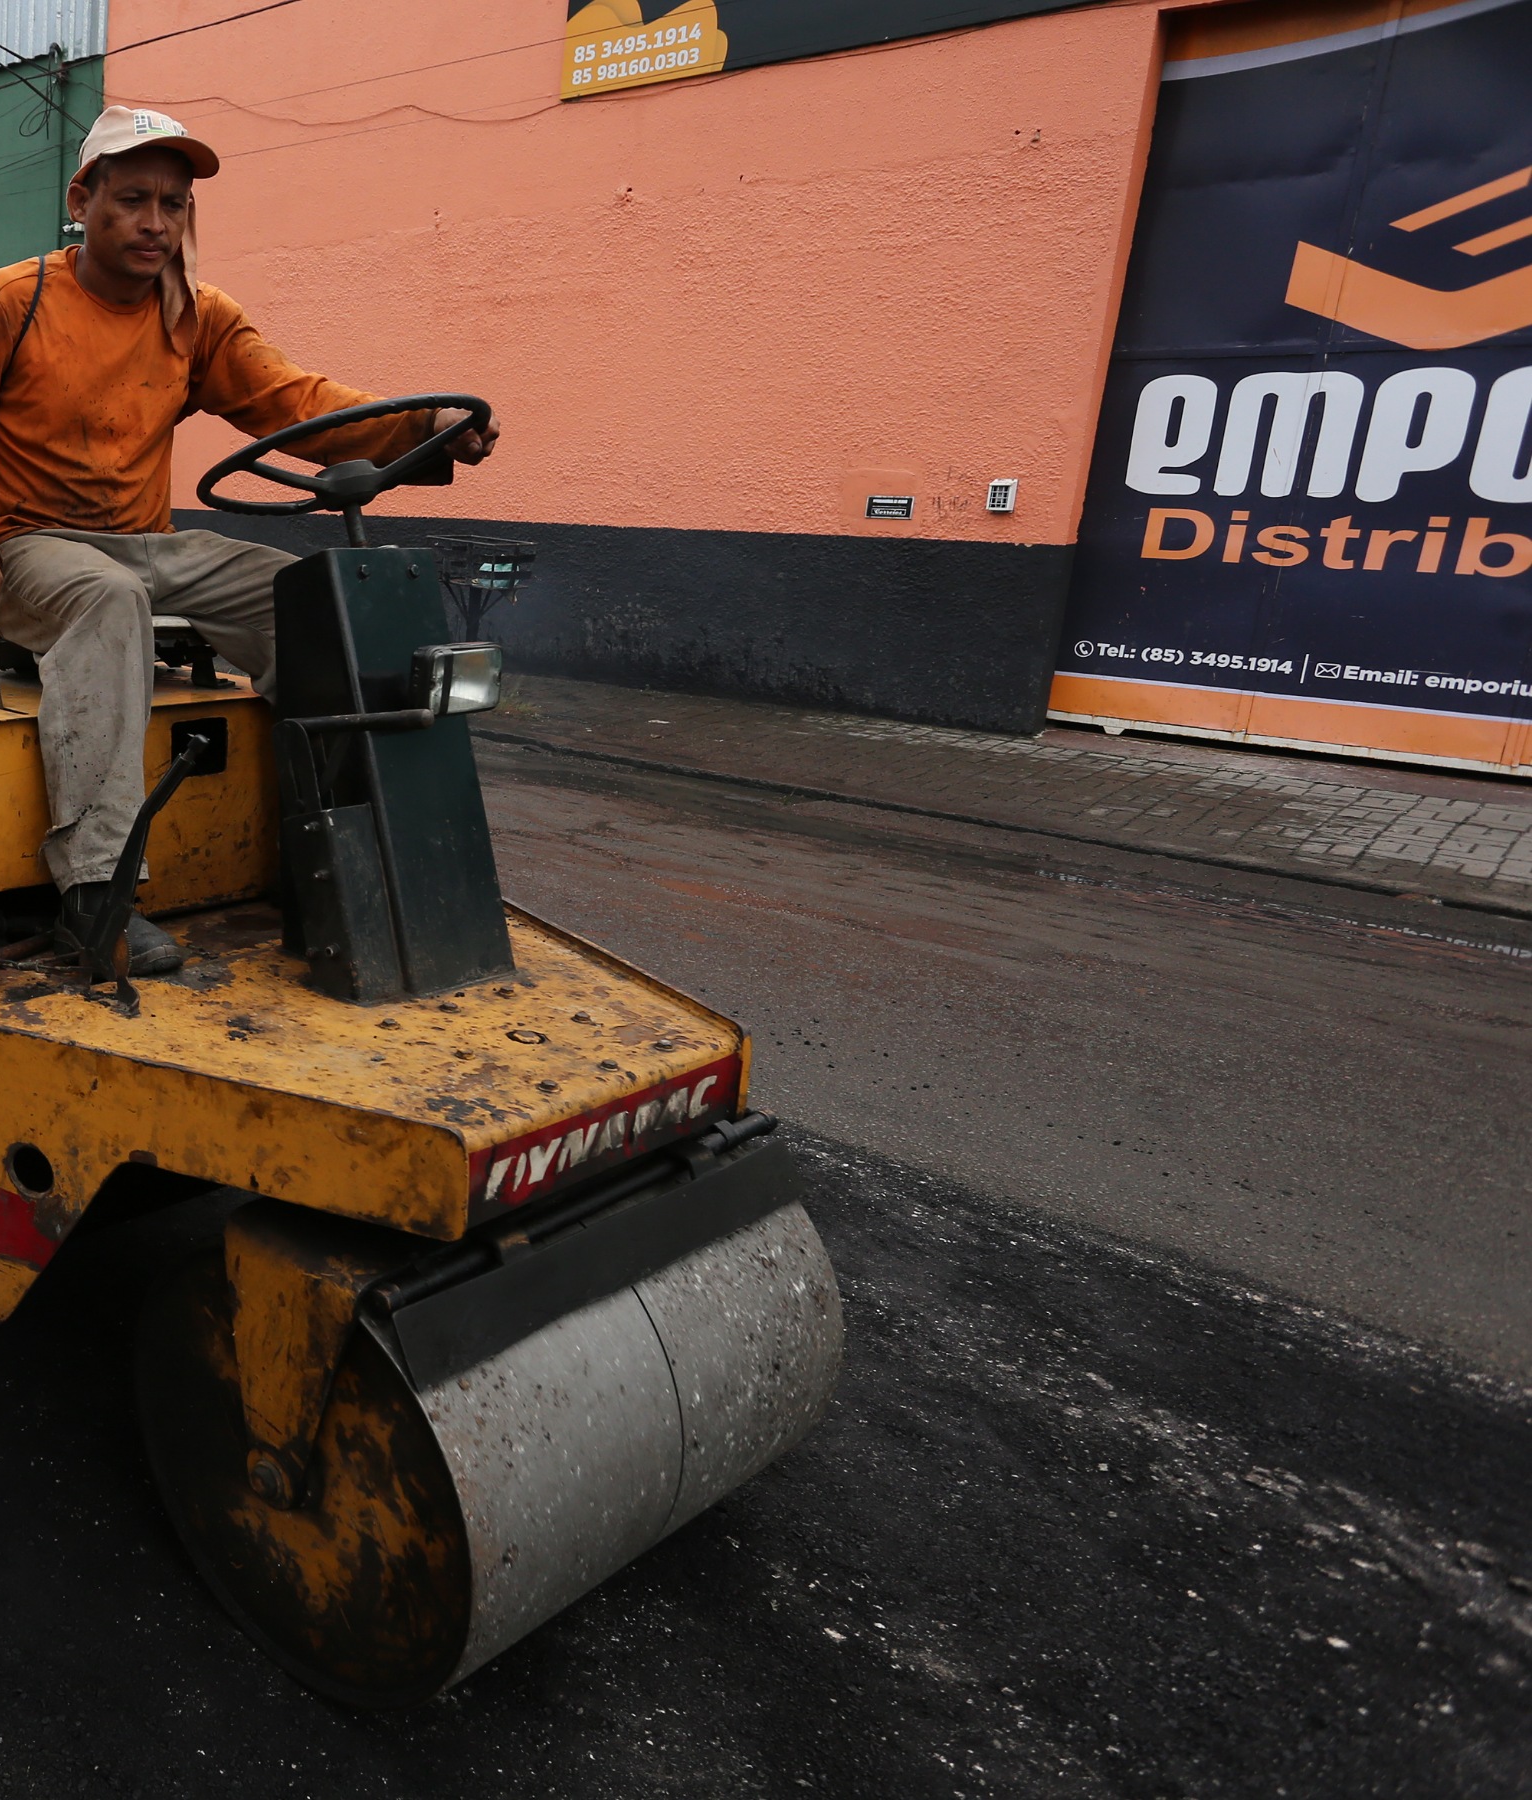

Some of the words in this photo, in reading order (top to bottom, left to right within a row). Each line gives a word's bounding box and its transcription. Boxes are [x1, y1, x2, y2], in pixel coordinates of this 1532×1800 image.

[571, 67, 593, 85] 85
[597, 47, 700, 81] 98160.0303
[574, 43, 596, 63] 85
[600, 22, 702, 59] 3495.1914
[1140, 507, 1532, 578] Distrib
[1097, 642, 1136, 659] Tel.:
[1140, 647, 1185, 665] (85)
[1189, 651, 1293, 675] 3495.1914
[1342, 665, 1419, 686] Email:
[1424, 674, 1532, 697] emporiu
